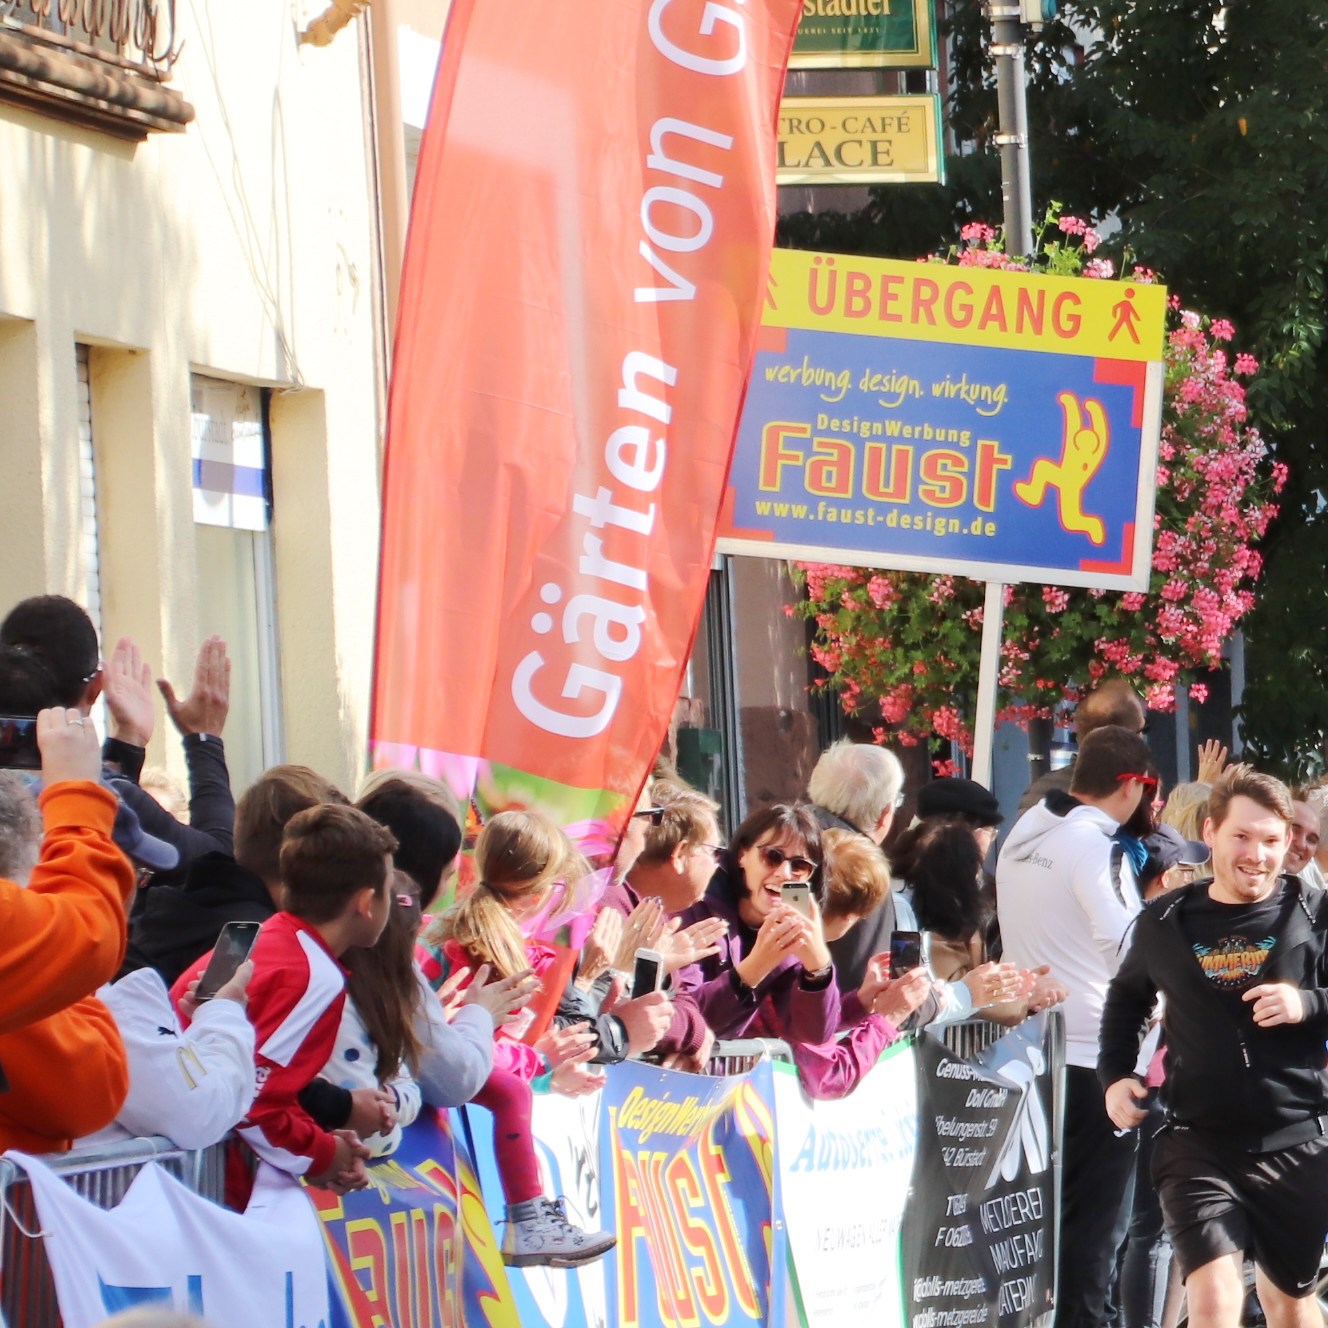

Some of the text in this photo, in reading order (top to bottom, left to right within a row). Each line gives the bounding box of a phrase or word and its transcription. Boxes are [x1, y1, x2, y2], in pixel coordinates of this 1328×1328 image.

[841, 111, 911, 135] CAFÉ
[777, 139, 894, 168] LACE
[808, 256, 1082, 339] ÜBERGANG
[765, 355, 1009, 417] werbung. design. wirkung.
[511, 349, 678, 740] Gärten
[633, 116, 733, 303] von
[816, 412, 972, 448] DesignWerbung
[758, 420, 1015, 513] Faust
[755, 501, 998, 538] www.faust-design.de
[936, 1058, 987, 1083] Genuss-M
